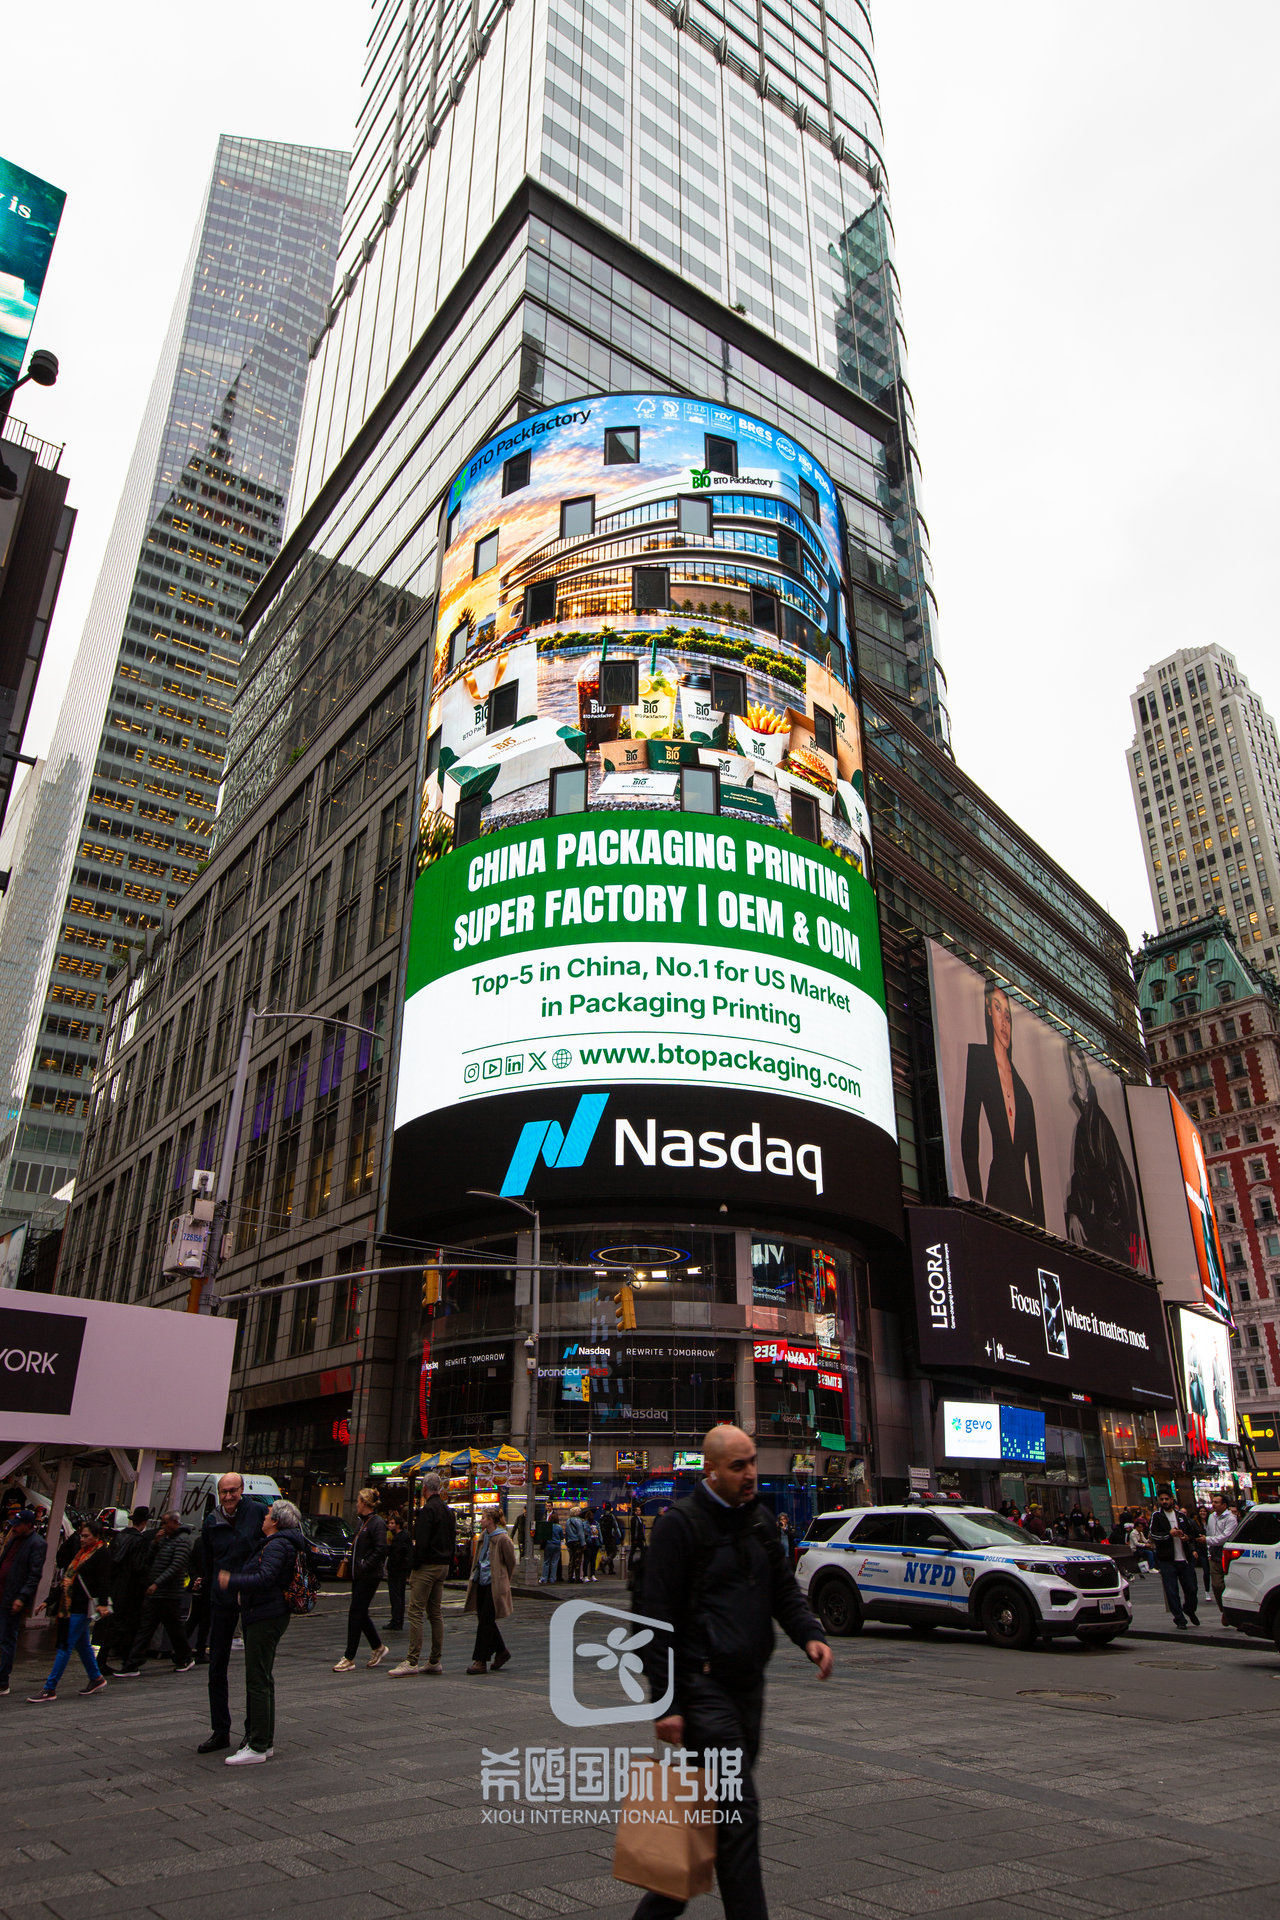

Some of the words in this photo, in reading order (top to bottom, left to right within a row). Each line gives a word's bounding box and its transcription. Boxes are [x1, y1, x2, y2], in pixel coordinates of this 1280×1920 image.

[8, 195, 31, 218] is
[469, 448, 494, 479] BTO
[496, 409, 592, 457] Packfactory
[713, 476, 729, 485] BTO
[729, 475, 774, 489] Packfactory
[468, 837, 547, 892] CHINA
[557, 829, 736, 872] PACKAGING
[746, 839, 851, 913] PRINTING
[453, 894, 536, 952] SUPER
[545, 884, 688, 929] FACTORY
[717, 890, 785, 939] OEM
[792, 911, 811, 947] &
[816, 914, 862, 972] ODM
[472, 964, 534, 996] Top-5
[539, 961, 561, 982] in
[567, 956, 649, 980] China,
[656, 956, 709, 979] No.1
[714, 959, 750, 982] for
[755, 966, 786, 990] US
[790, 974, 852, 1014] Market
[541, 996, 563, 1018] in
[570, 991, 706, 1020] Packaging
[712, 996, 801, 1034] Printing
[579, 1043, 862, 1098] www.btopackaging.com
[614, 1118, 825, 1196] Nasdaq
[925, 1243, 949, 1329] LEGORA
[1009, 1284, 1041, 1317] Focus
[1065, 1306, 1092, 1333] where
[1090, 1312, 1100, 1336] it
[1099, 1320, 1129, 1344] matters
[1128, 1331, 1150, 1350] most.
[445, 1357, 467, 1367] REWRITE
[468, 1353, 505, 1364] TOMORROW
[578, 1346, 611, 1357] Nasdaq
[667, 1349, 716, 1358] TOMORROW
[622, 1408, 669, 1422] Nasdaq
[965, 1418, 992, 1434] gevo
[904, 1561, 956, 1587] NYPD
